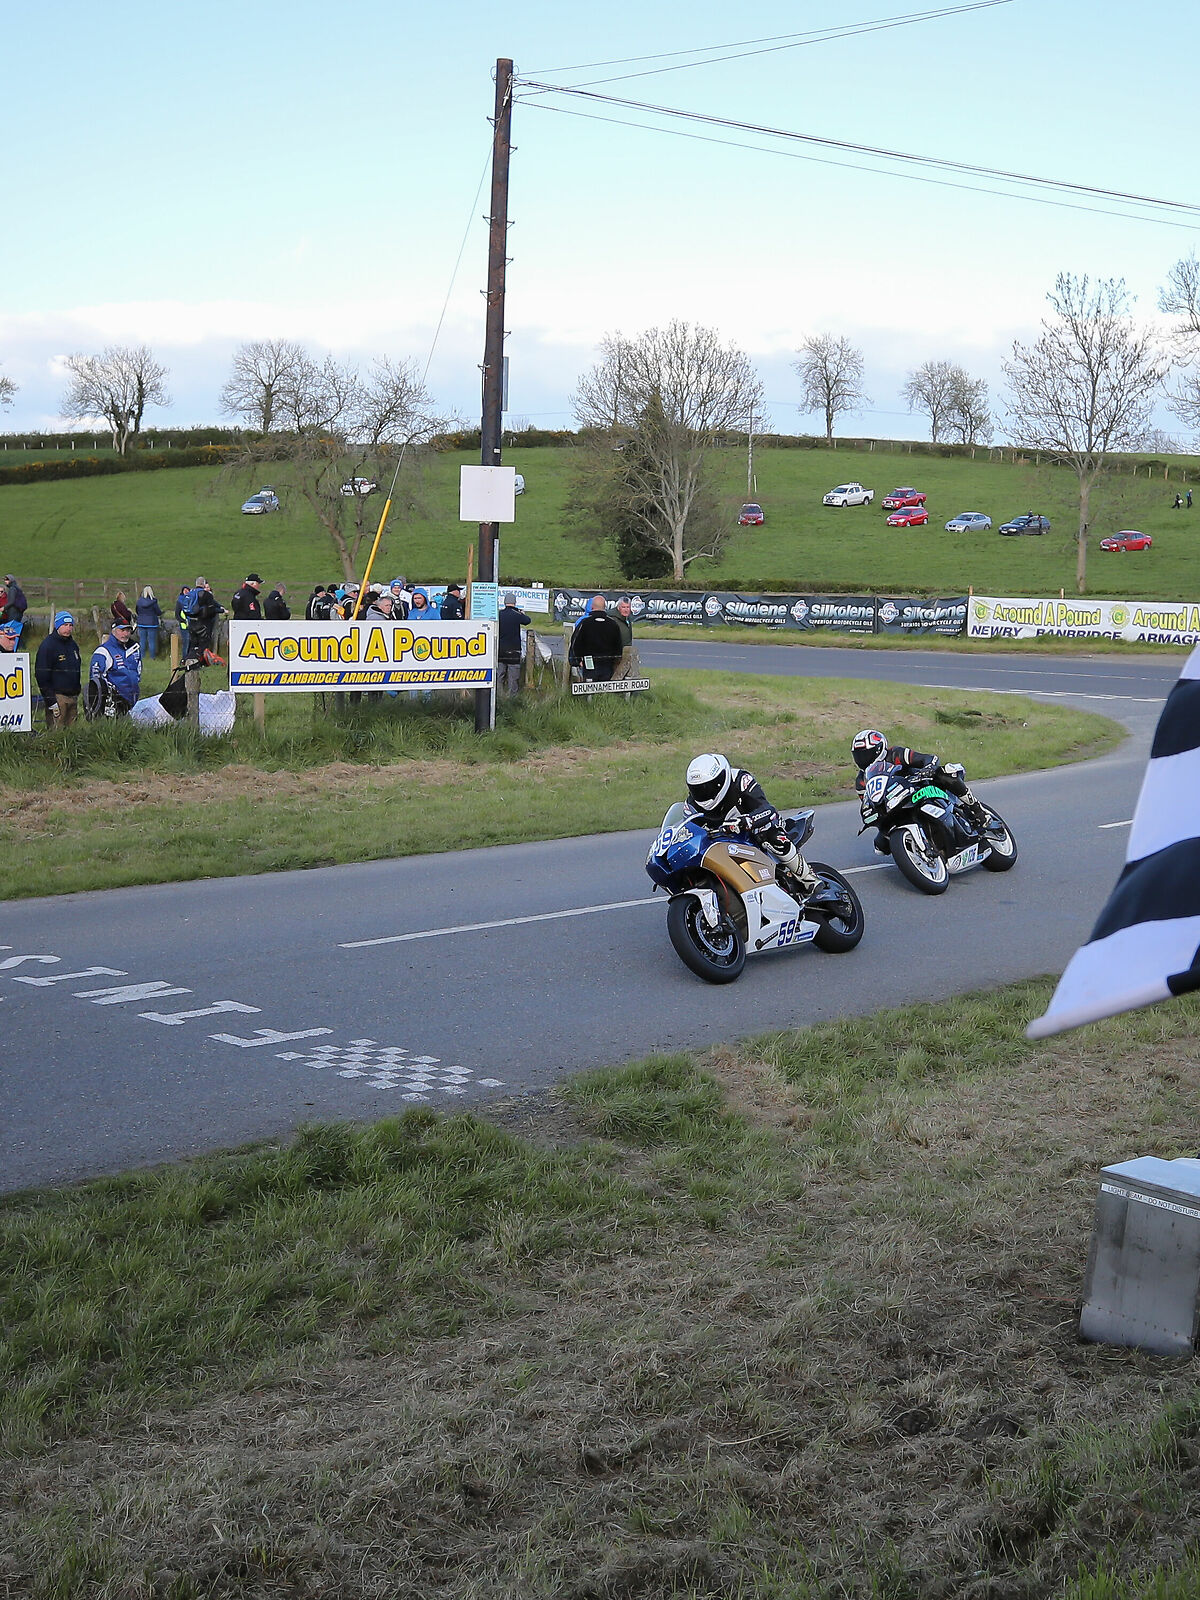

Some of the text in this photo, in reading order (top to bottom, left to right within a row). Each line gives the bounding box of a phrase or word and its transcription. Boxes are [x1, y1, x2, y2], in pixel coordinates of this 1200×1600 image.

[514, 590, 549, 600] CONCRETE
[647, 599, 703, 613] Silkolene
[725, 601, 787, 616] Silkolene
[810, 604, 875, 618] Silkolene
[902, 604, 967, 620] Silkolene
[993, 602, 1101, 627] Around A Pound
[1132, 606, 1188, 631] Around
[1188, 606, 1200, 632] A
[971, 625, 1023, 637] NEWRY
[238, 627, 486, 663] Around A Pound
[238, 670, 487, 685] NEWRY BANBRIDGE ARMAGH NEWCASTLE LURGAN
[573, 680, 649, 693] DRUMNAMETHER ROAD
[0, 713, 24, 726] GAN
[777, 919, 796, 947] 59
[1107, 1185, 1125, 1197] LIGHT
[1125, 1189, 1143, 1201] EAM
[1148, 1197, 1158, 1205] DO
[1158, 1200, 1171, 1209] NOT
[1171, 1203, 1200, 1217] DISTURB
